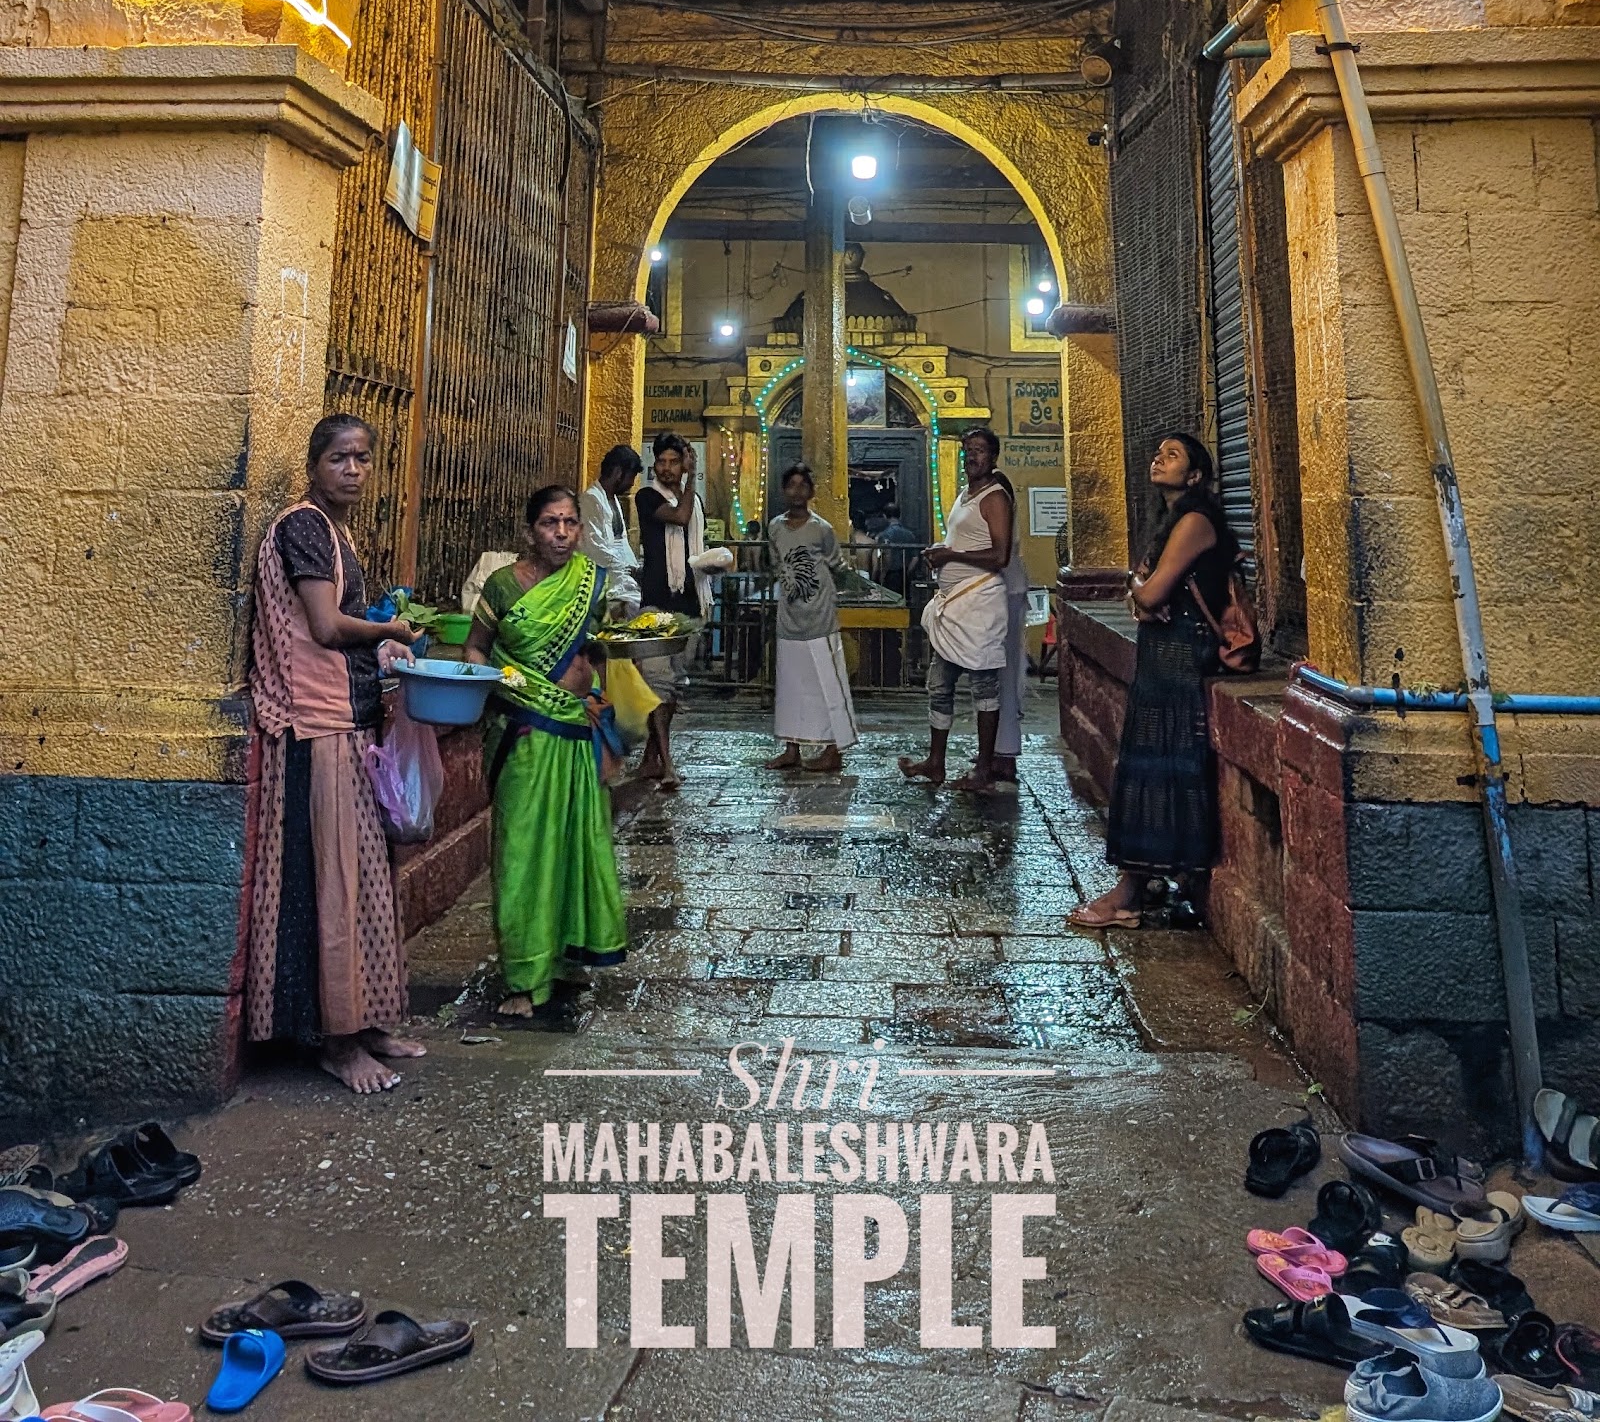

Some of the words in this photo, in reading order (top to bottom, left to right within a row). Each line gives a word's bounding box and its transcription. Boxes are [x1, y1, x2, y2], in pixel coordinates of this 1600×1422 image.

[1004, 442, 1050, 455] Foreigners
[1054, 442, 1064, 452] Ar
[1005, 457, 1021, 467] Not
